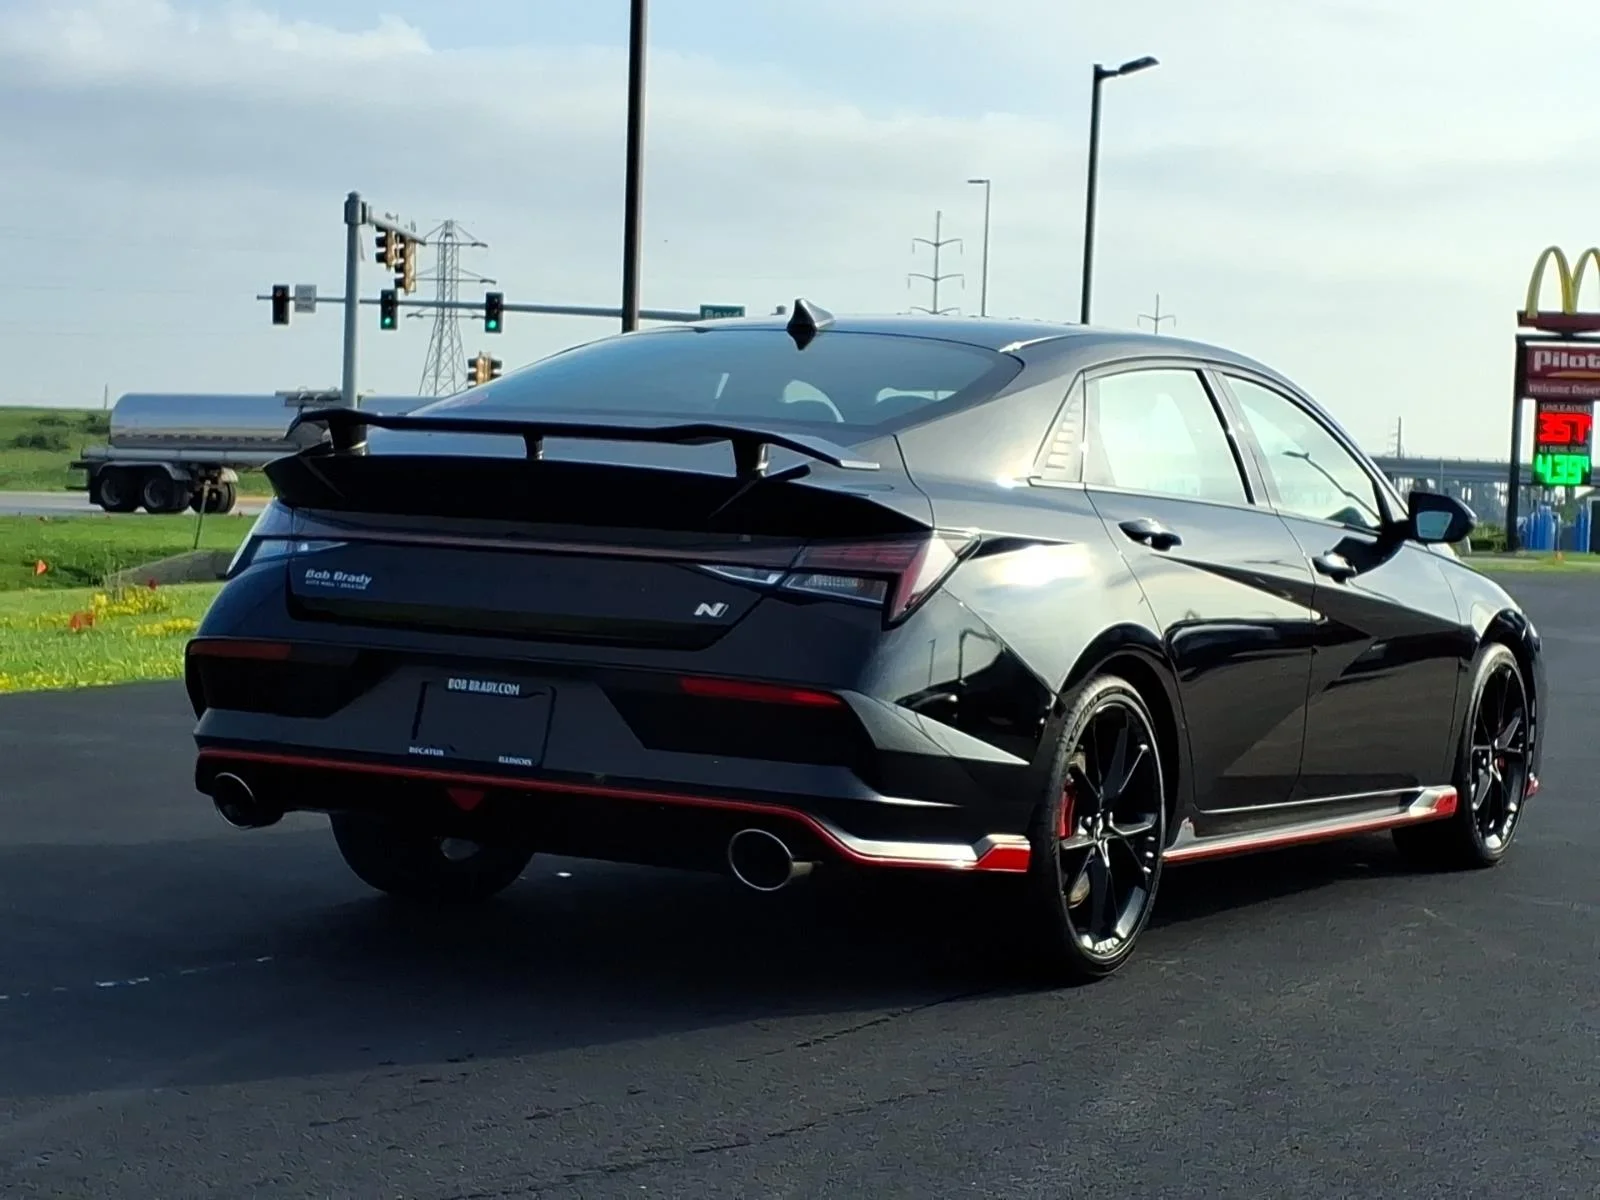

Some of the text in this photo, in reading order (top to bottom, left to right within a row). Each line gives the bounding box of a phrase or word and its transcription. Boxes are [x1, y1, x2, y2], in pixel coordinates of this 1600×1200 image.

[1534, 351, 1600, 371] Pilot
[305, 569, 372, 585] Bob Brady
[694, 602, 729, 617] N
[448, 678, 520, 695] BOB BRADY.COM
